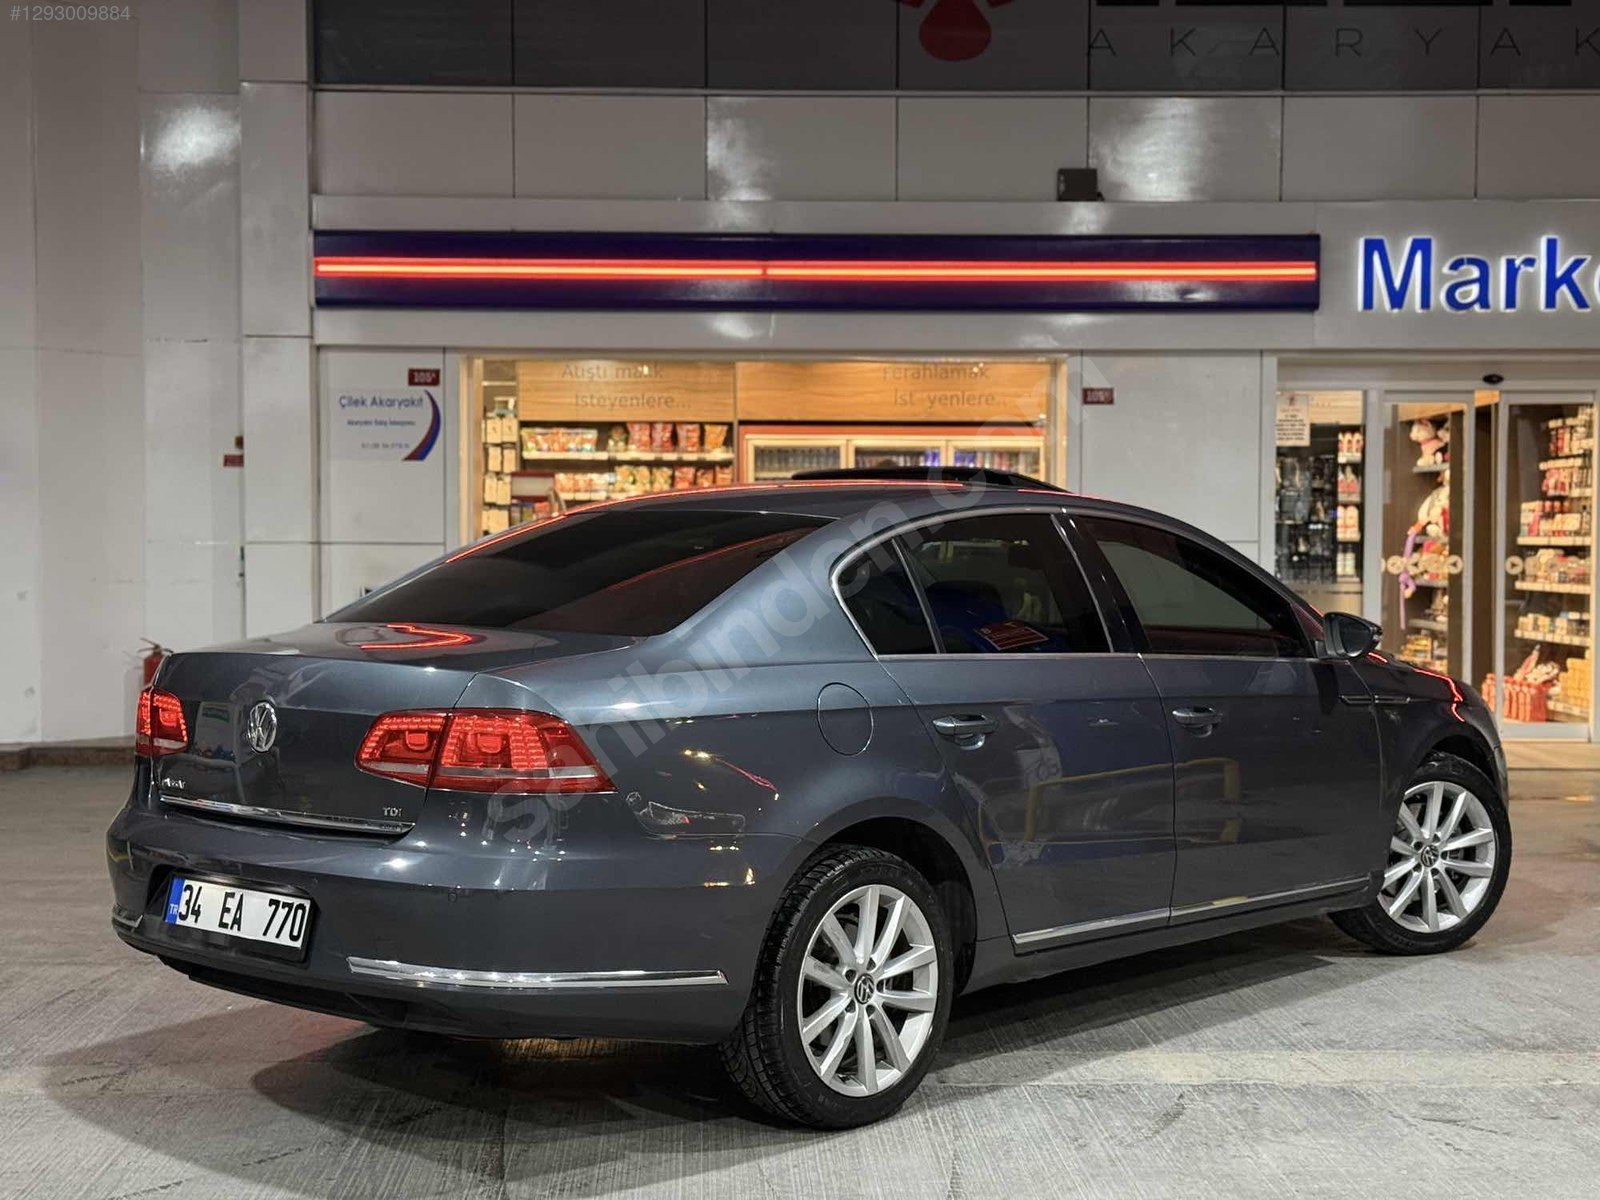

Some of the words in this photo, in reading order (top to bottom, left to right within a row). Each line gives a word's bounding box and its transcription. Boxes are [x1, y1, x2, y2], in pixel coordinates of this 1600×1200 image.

[1358, 234, 1600, 313] Mark
[338, 395, 367, 409] Çilek
[168, 902, 179, 916] TR
[178, 884, 203, 923] 34
[218, 891, 244, 932] EA
[262, 898, 307, 942] 770
